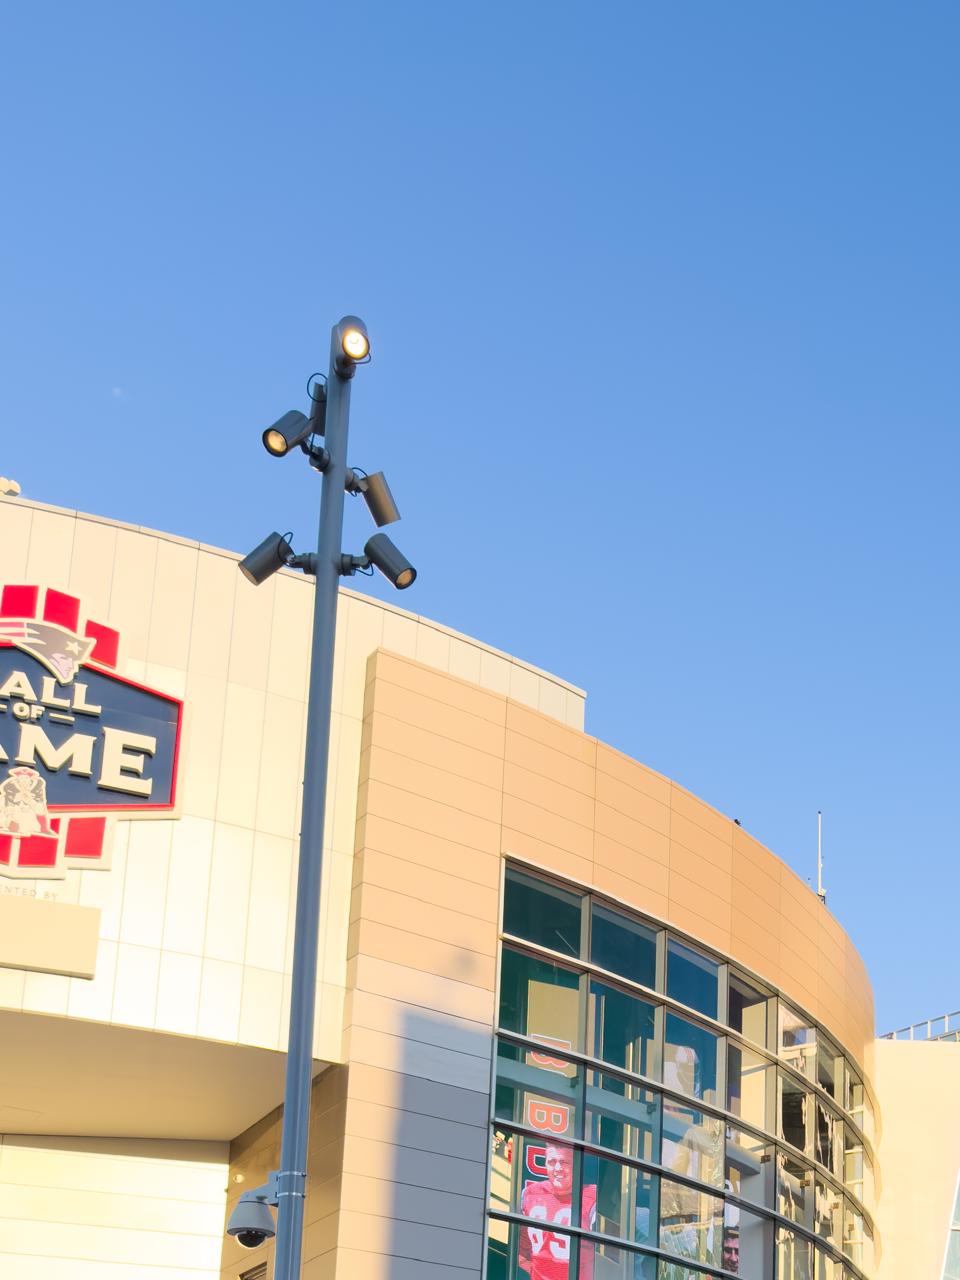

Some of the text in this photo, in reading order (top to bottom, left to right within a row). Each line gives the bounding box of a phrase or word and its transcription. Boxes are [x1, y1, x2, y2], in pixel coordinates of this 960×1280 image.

[12, 702, 45, 721] OF
[0, 722, 157, 798] ME
[0, 883, 37, 898] NTED
